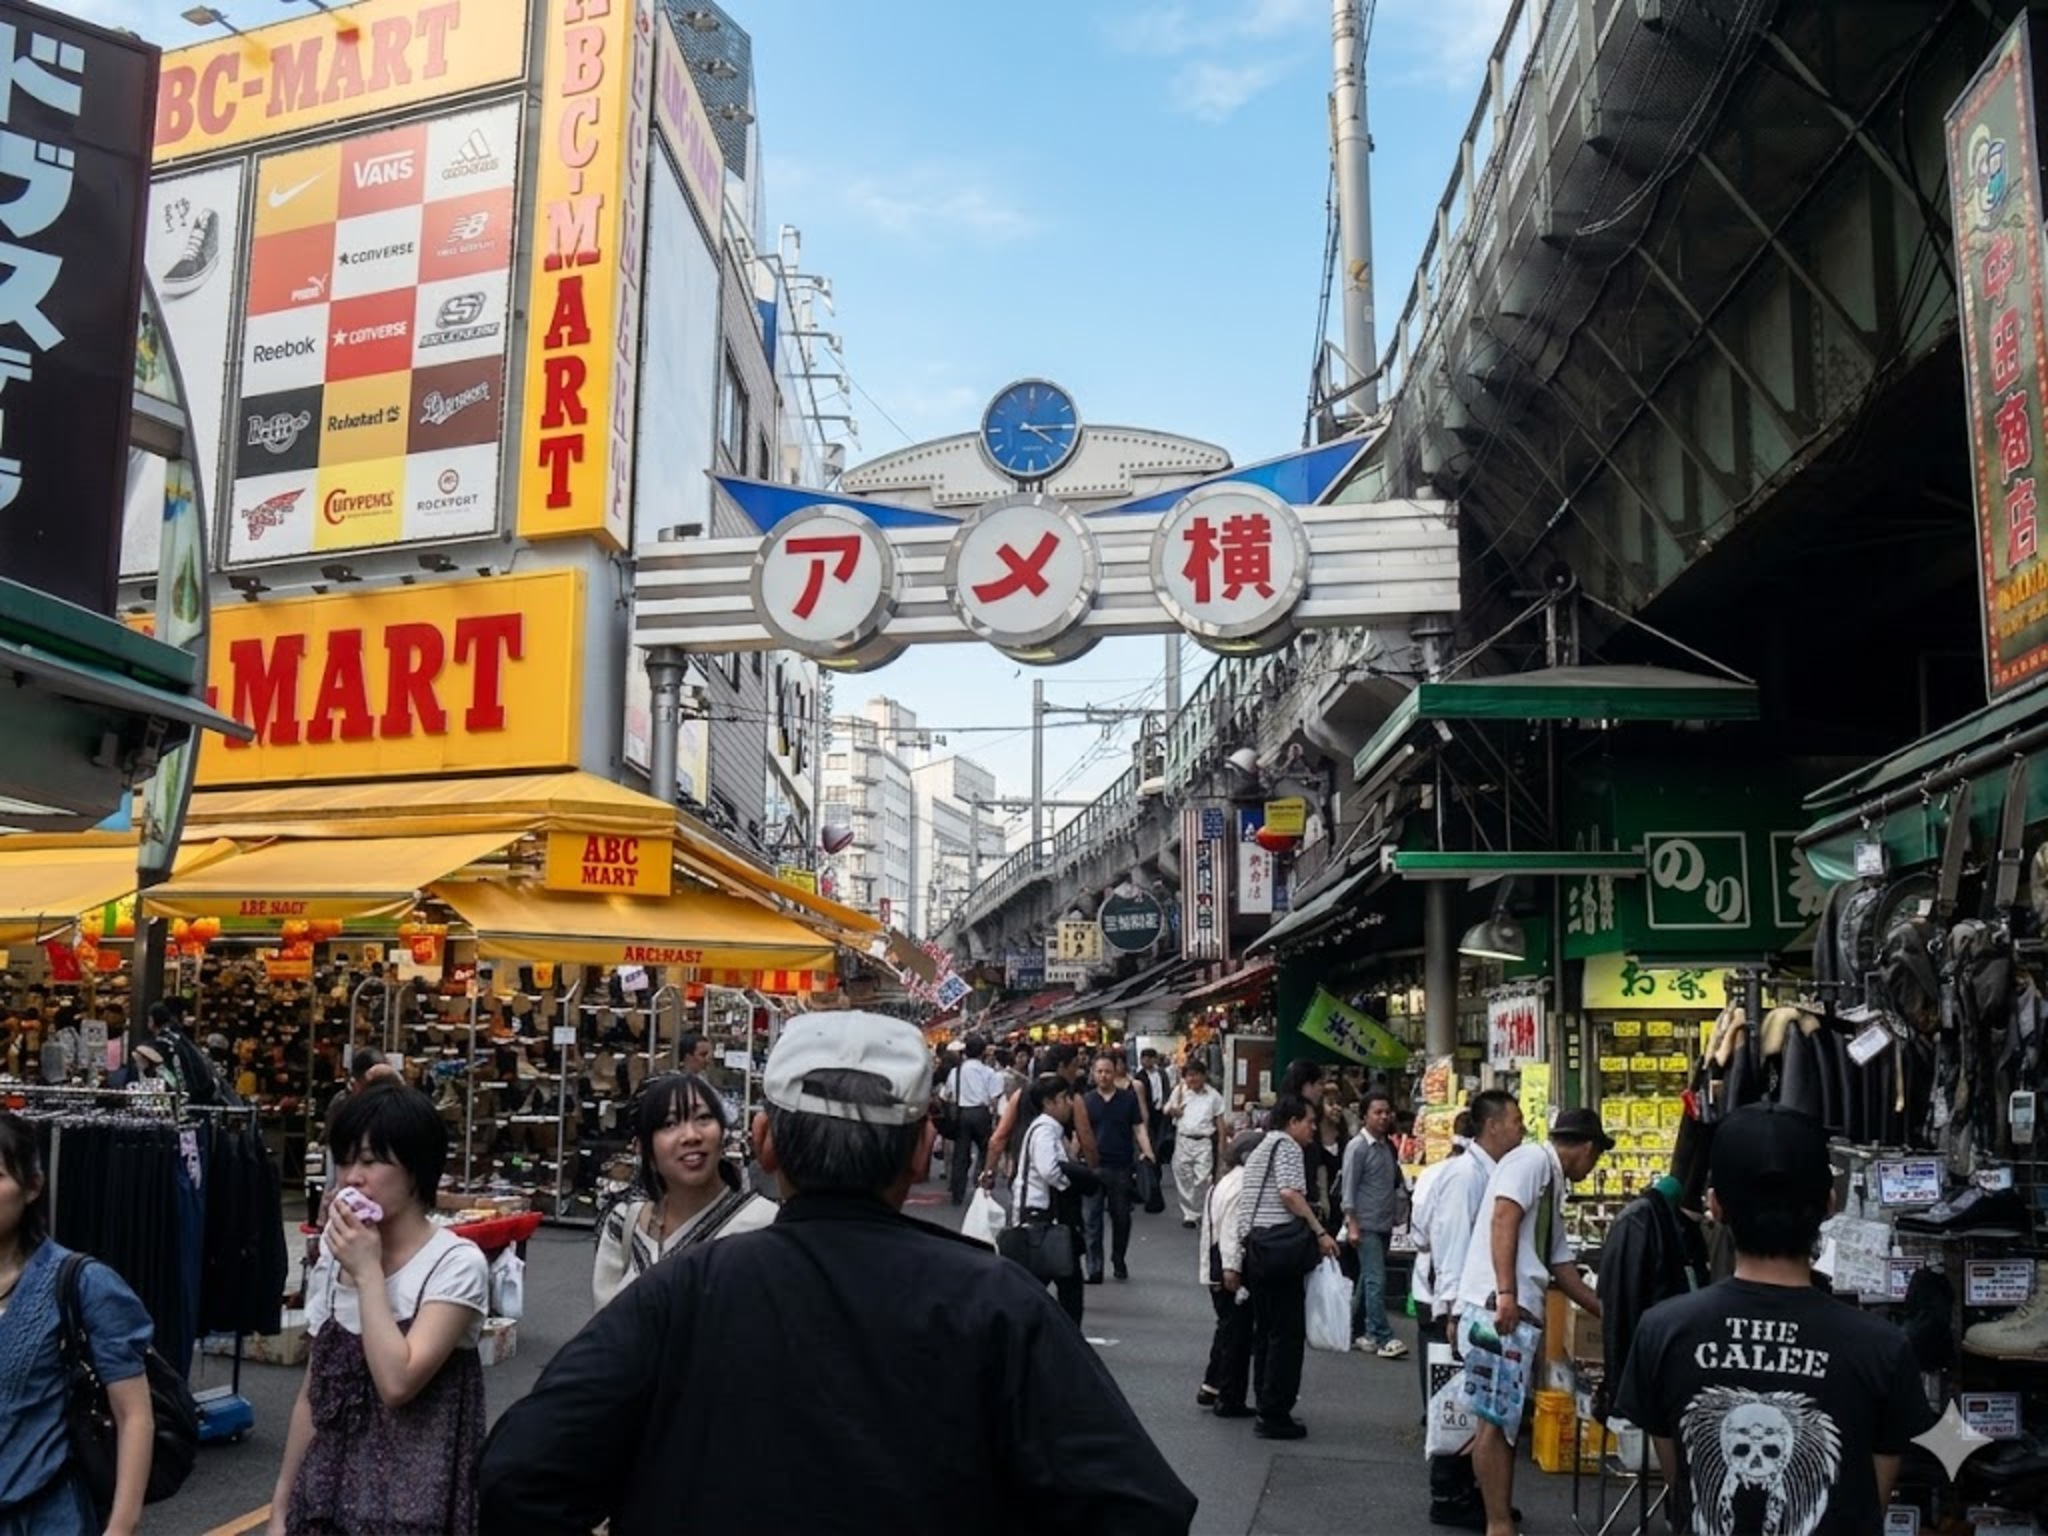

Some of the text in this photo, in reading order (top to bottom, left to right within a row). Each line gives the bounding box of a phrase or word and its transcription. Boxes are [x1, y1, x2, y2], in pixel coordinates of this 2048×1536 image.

[353, 150, 415, 189] VANS
[351, 242, 415, 265] CONVERSE
[253, 336, 317, 364] Reebok
[785, 513, 1275, 621] アメ横
[582, 833, 639, 864] ABC
[582, 865, 639, 887] MART
[1653, 839, 1742, 922] のり
[1726, 1317, 1799, 1343] THE
[1694, 1341, 1830, 1379] CALEE
